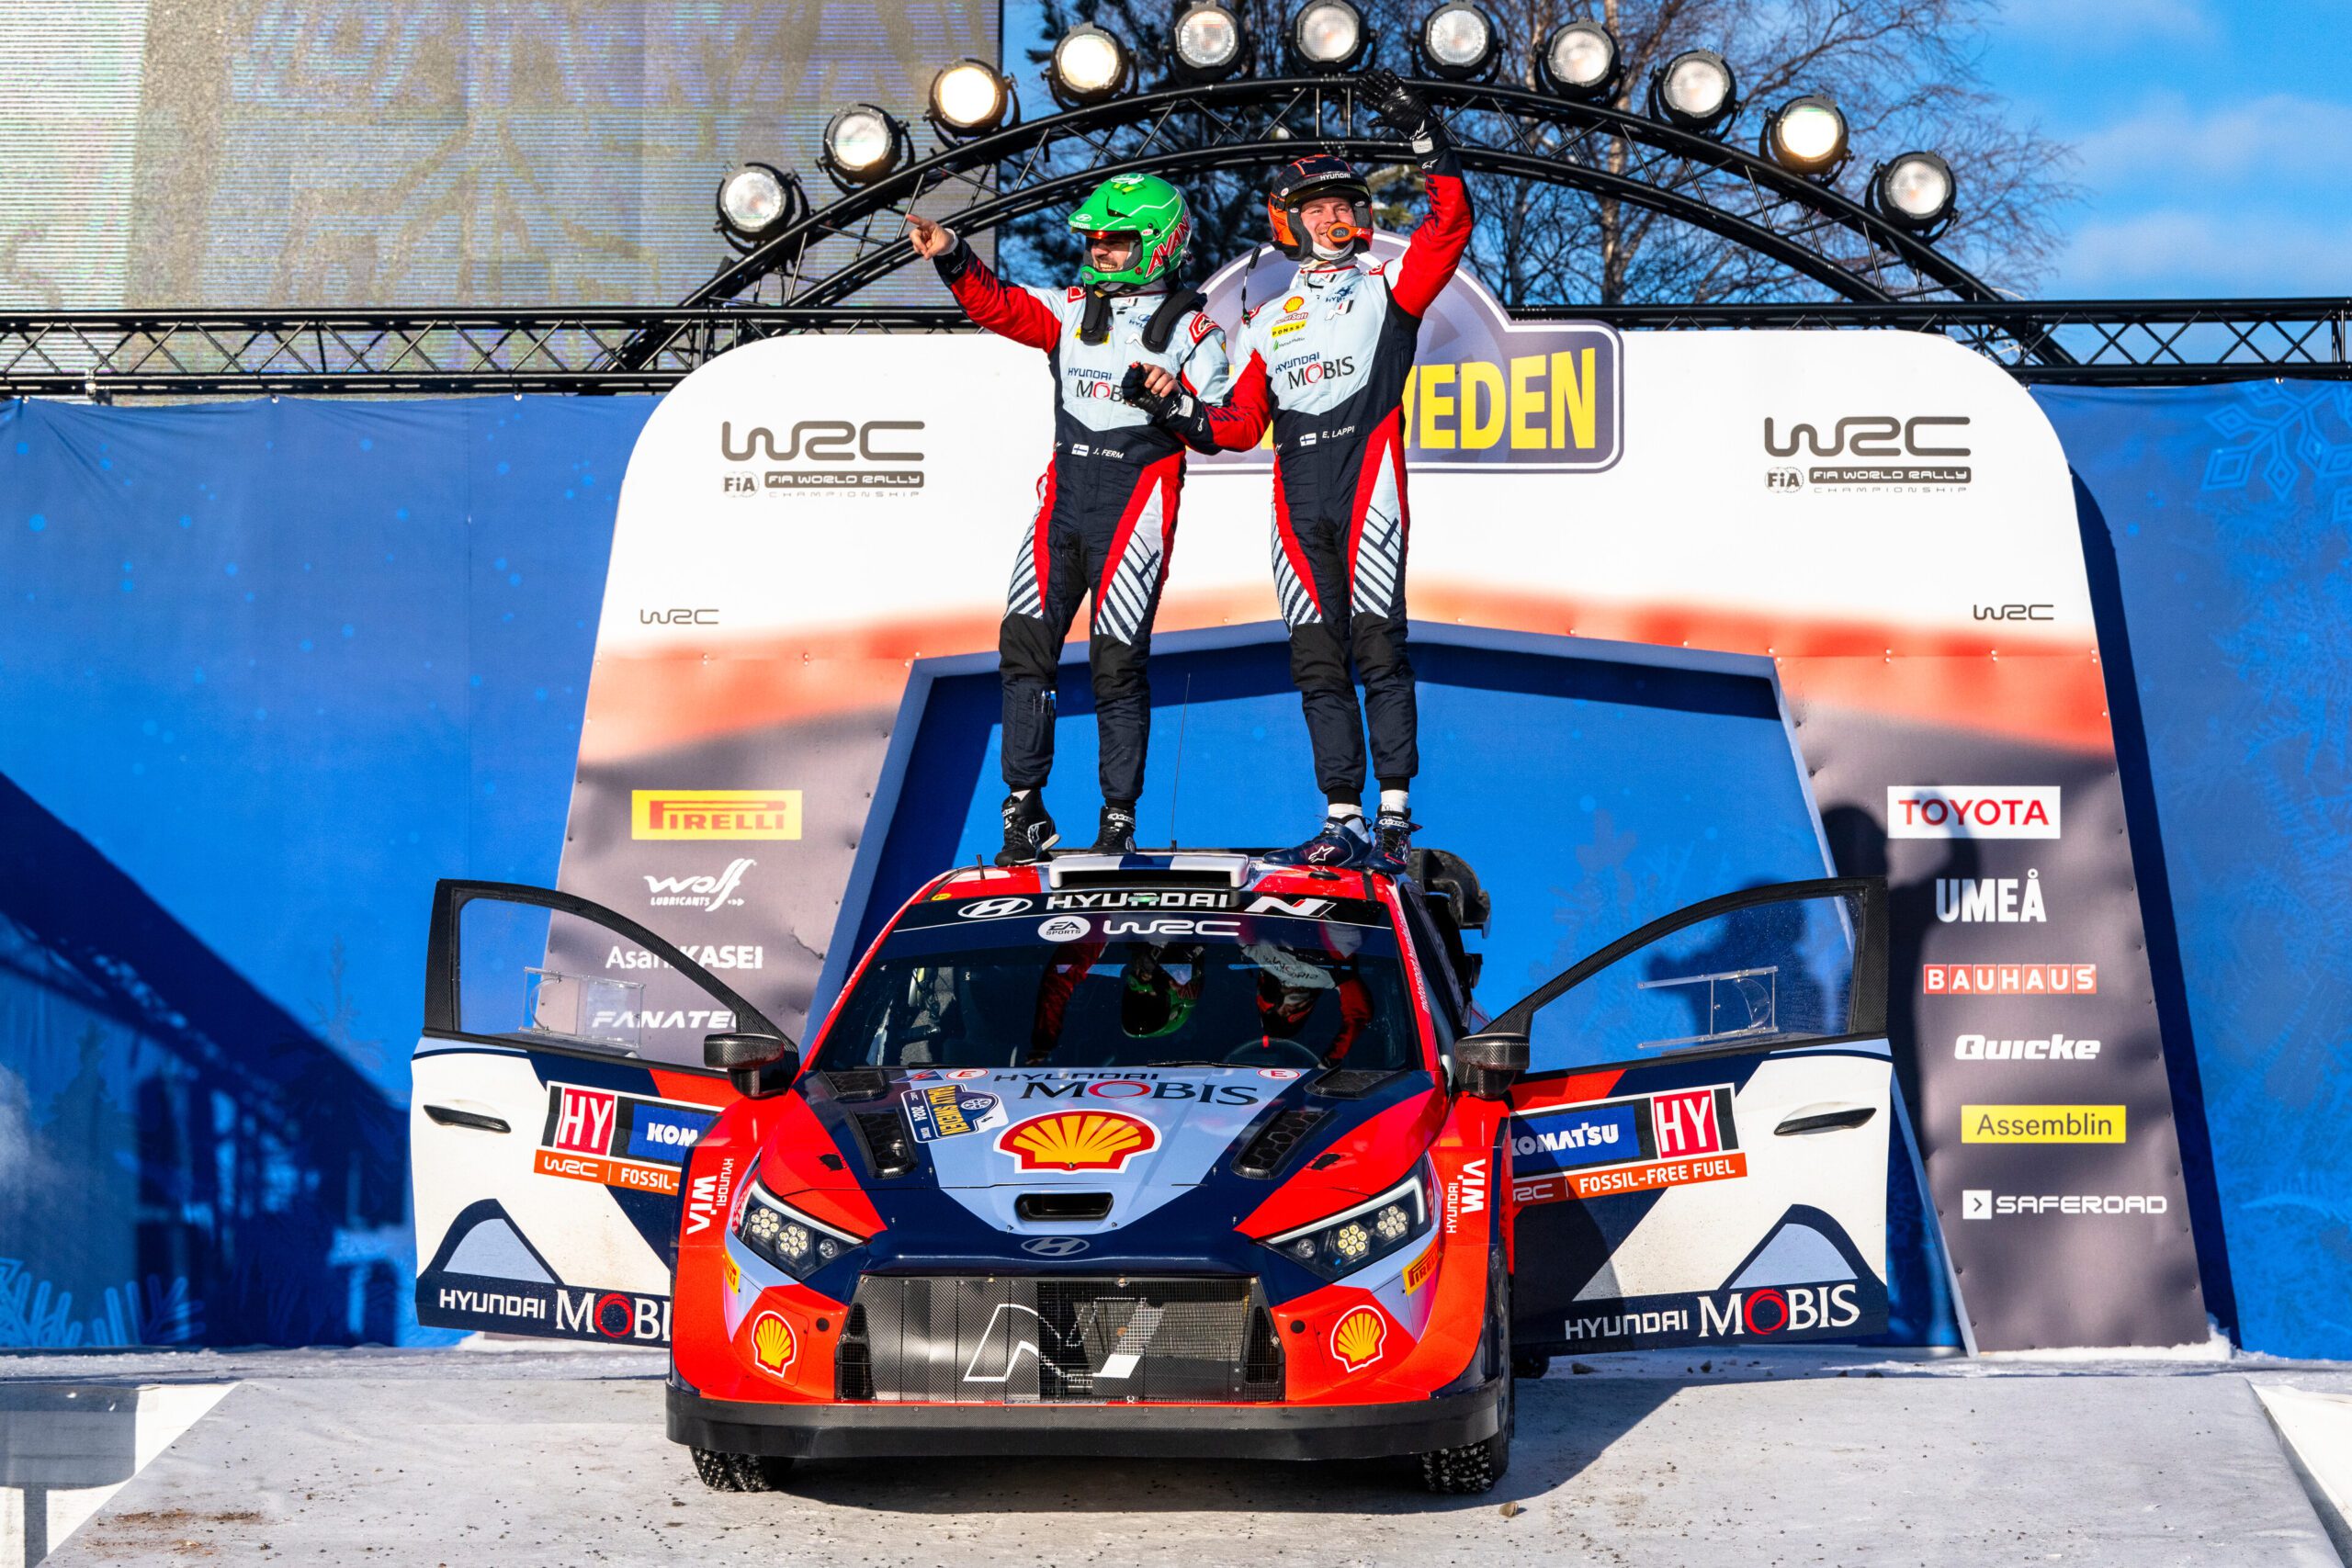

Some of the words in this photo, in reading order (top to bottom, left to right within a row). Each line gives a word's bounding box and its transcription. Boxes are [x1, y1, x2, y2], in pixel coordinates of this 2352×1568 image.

[1320, 173, 1351, 181] HYUNDAI
[1068, 367, 1113, 381] HYUNDAI
[1275, 352, 1320, 374] HYUNDAI
[1288, 356, 1355, 389] MOBIS
[1077, 379, 1123, 402] MOB
[722, 421, 925, 461] WRC
[1322, 431, 1330, 439] E.
[1332, 425, 1355, 438] LAPPI
[1764, 416, 1971, 457] WRC
[1102, 449, 1125, 459] FERM
[768, 475, 793, 484] FIA
[797, 475, 857, 484] WORLD
[862, 475, 920, 484] RALLY
[1813, 470, 1838, 479] FIA
[1843, 470, 1904, 479] WORLD
[1908, 470, 1967, 479] RALLY
[639, 609, 719, 625] WRC
[1973, 604, 2054, 620] WRC
[650, 800, 786, 829] PIRELLI
[1898, 799, 2050, 825] TOYOTA
[650, 896, 710, 906] LUBRICANTS
[1046, 893, 1227, 910] HYUNDAI
[1936, 868, 2047, 922] UMEÅ
[1103, 919, 1240, 935] WRC
[1928, 967, 2094, 990] BAUHAUS
[1954, 1033, 2101, 1060] Quicke
[994, 1072, 1159, 1082] HYUNDAI
[1020, 1081, 1260, 1106] MOBIS
[558, 1094, 614, 1148] HY
[910, 1105, 928, 1122] 2024
[933, 1105, 971, 1135] SWEDEN
[1656, 1090, 1711, 1152] HY
[1976, 1112, 2112, 1136] Assemblin
[544, 1156, 598, 1179] WRC
[716, 1157, 735, 1207] HYUNDAI
[1513, 1183, 1555, 1202] RC
[1579, 1164, 1689, 1193] FOSSIL-FREE
[1693, 1158, 1736, 1179] FUEL
[1446, 1182, 1459, 1234] HYUNDAI
[1996, 1195, 2167, 1214] SAFEROAD
[439, 1289, 547, 1320] HYUNDAI
[556, 1289, 671, 1341] MOBI
[1565, 1309, 1688, 1340] HYUNDAI
[1698, 1283, 1860, 1338] MOBIS
